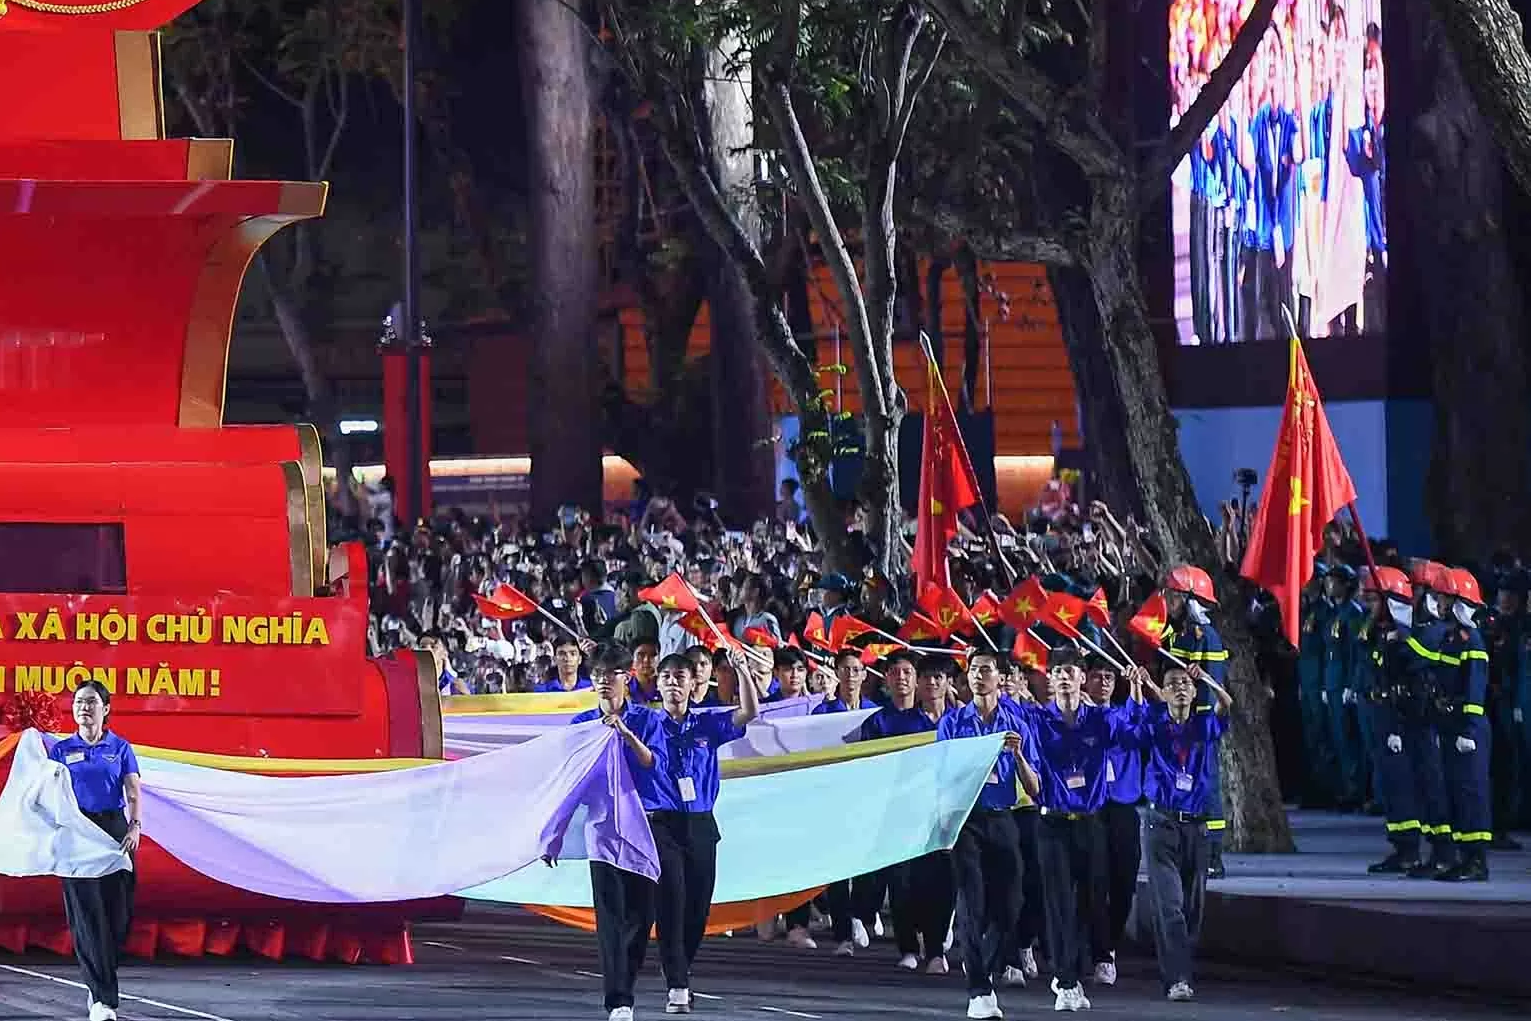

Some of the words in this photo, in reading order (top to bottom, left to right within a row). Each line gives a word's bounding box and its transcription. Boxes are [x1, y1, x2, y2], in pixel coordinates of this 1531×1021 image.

[14, 607, 66, 640] XÃ
[76, 608, 137, 645] HỘI
[146, 607, 212, 644] CHỦ
[222, 611, 330, 645] NGHĨA
[14, 660, 117, 694] MUÔN
[126, 662, 221, 696] NĂM!
